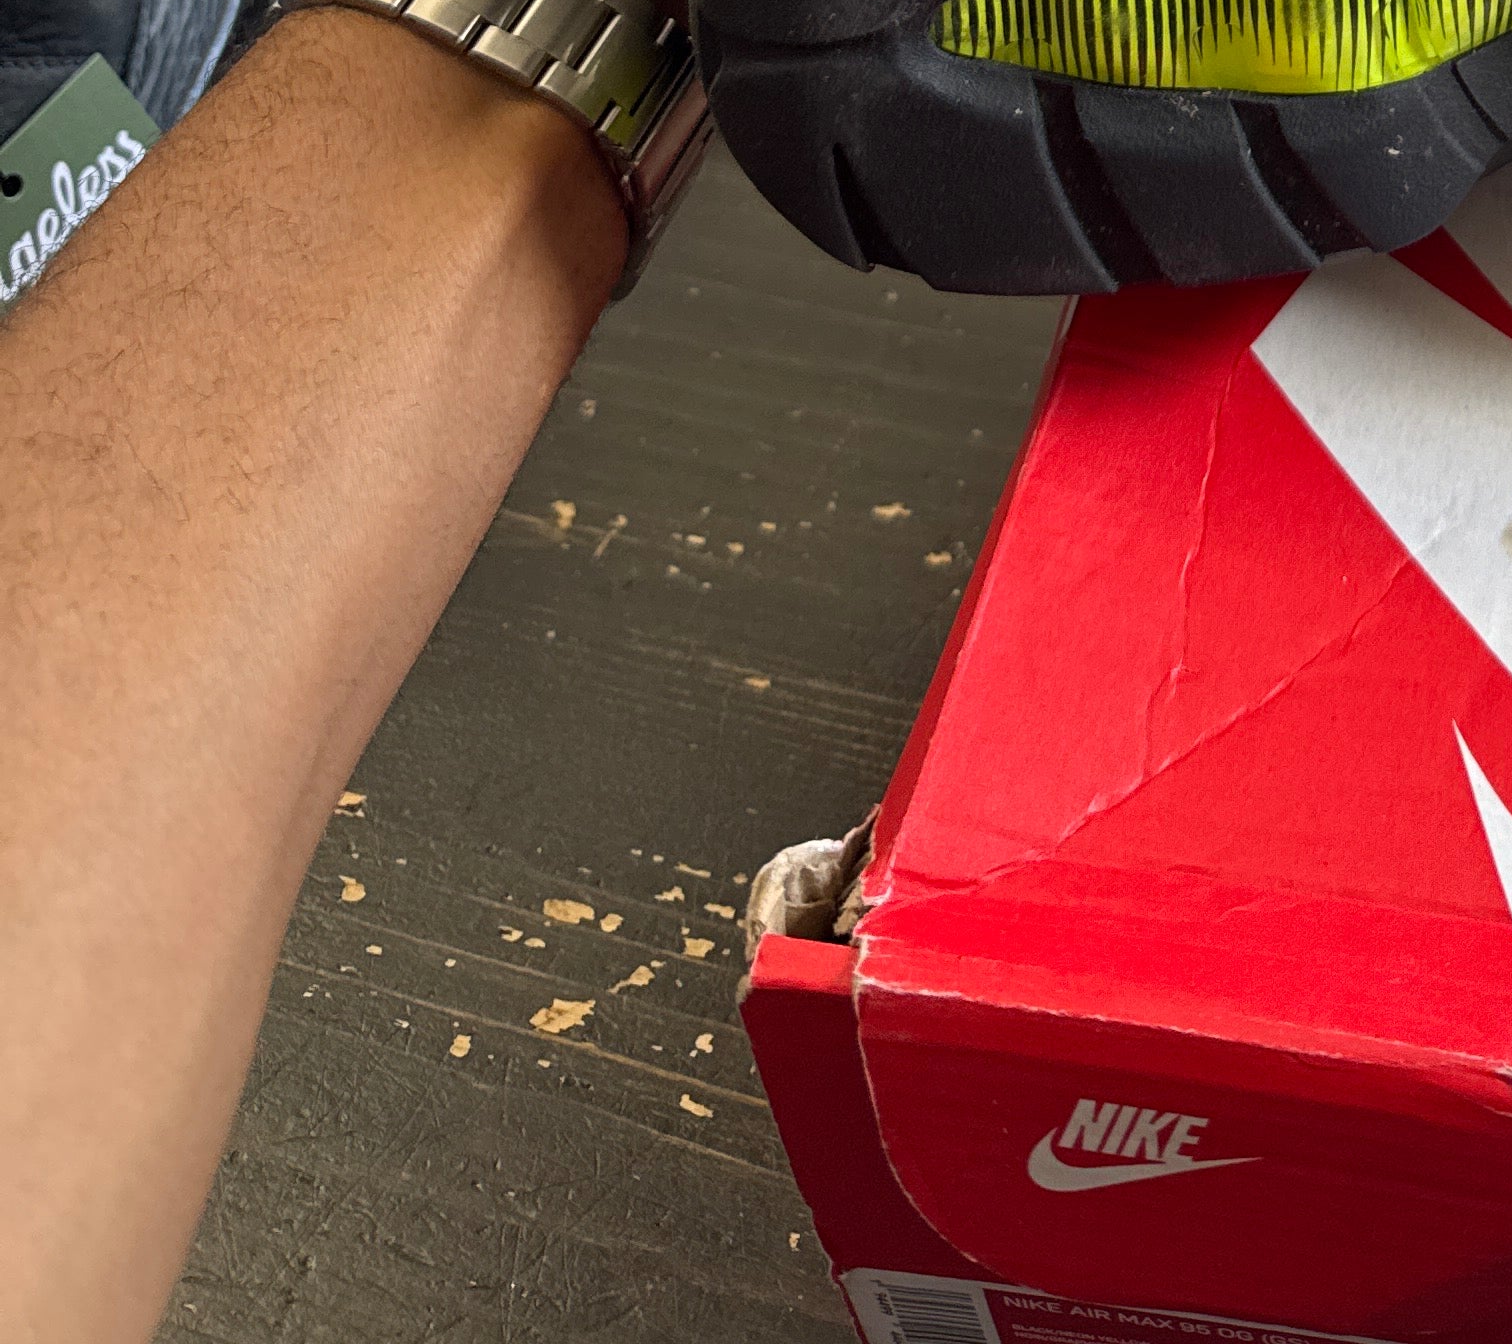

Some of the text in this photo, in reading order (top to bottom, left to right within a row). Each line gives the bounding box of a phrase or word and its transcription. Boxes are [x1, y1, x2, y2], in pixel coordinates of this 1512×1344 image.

[1058, 1098, 1209, 1164] NIKE
[1003, 1296, 1310, 1344] NIKE AIR MAX 95 OG (GS
